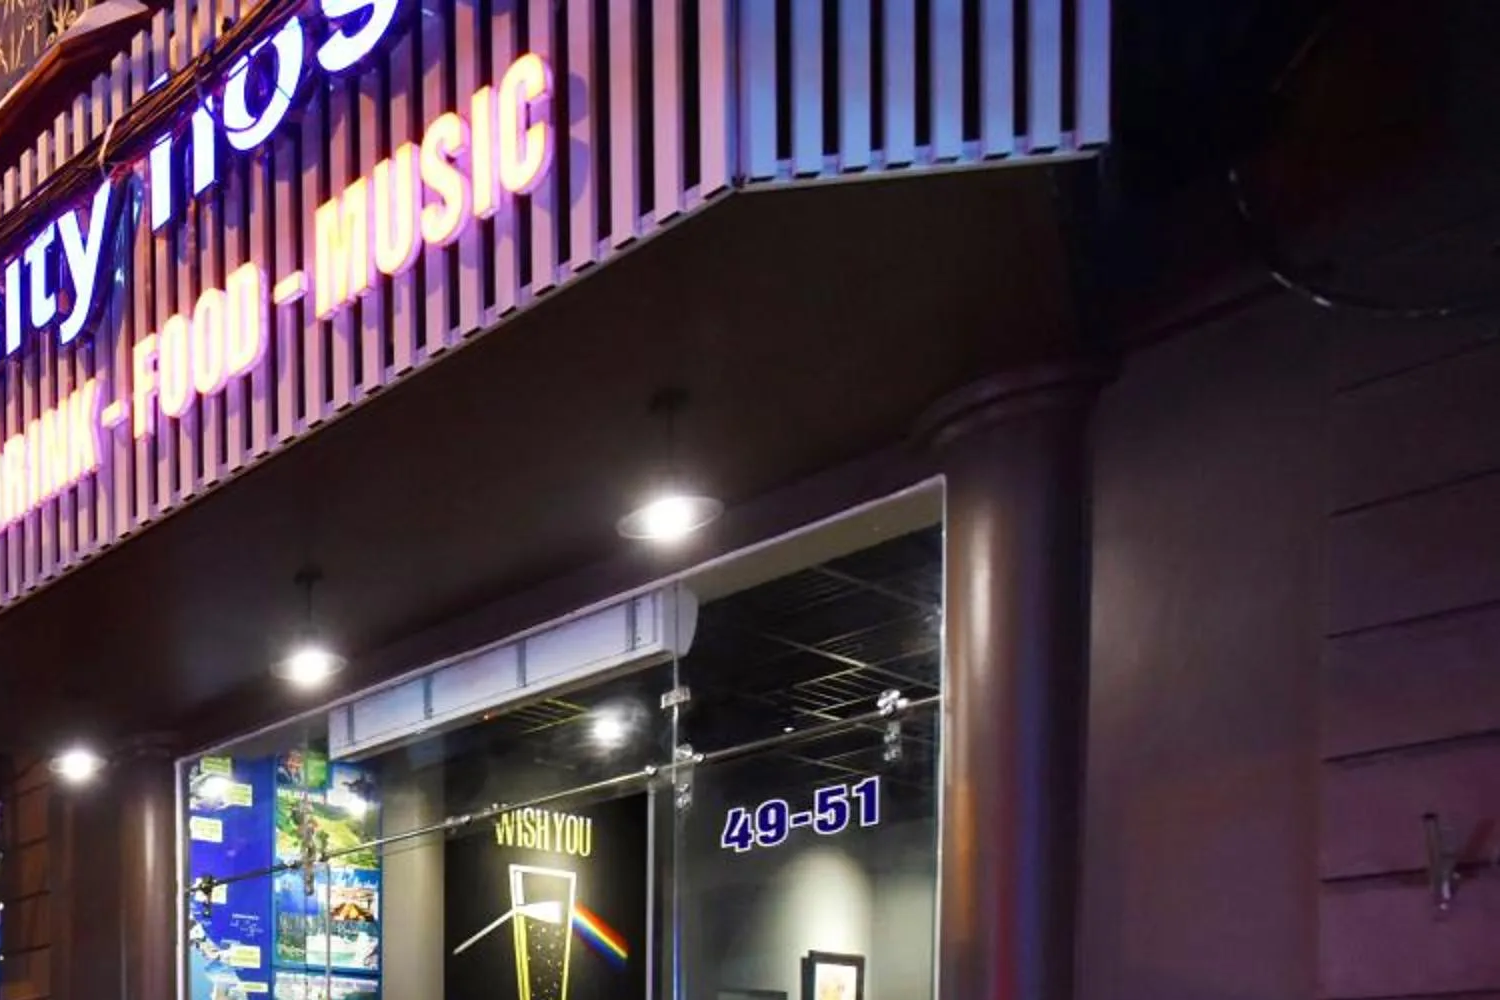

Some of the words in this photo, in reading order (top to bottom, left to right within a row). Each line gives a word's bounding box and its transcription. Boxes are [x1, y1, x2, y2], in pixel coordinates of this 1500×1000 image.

[133, 262, 266, 442] FOOD
[315, 52, 553, 321] MUSIC
[495, 806, 549, 852] WISH
[552, 811, 593, 857] YOU
[720, 775, 881, 853] 49-51
